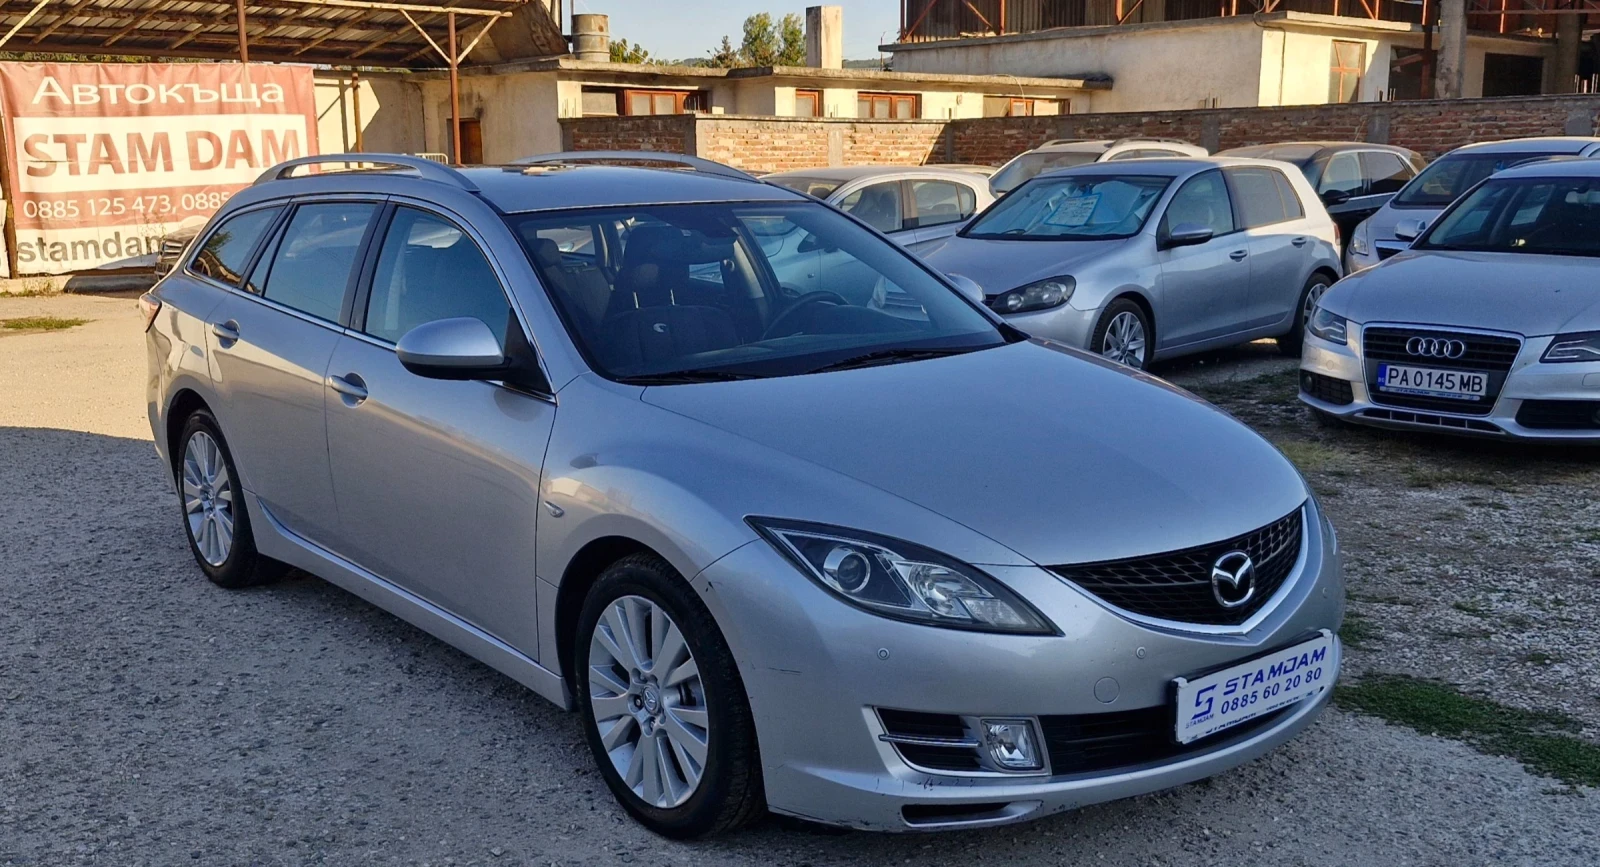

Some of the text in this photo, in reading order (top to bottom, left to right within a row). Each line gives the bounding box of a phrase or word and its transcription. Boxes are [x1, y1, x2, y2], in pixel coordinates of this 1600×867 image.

[32, 76, 284, 107] Автокъща
[23, 129, 300, 177] STAM DAM
[23, 199, 80, 219] 0885
[87, 197, 126, 215] 125
[131, 195, 177, 214] 473,
[1388, 367, 1483, 393] PA 0145 MB
[1223, 646, 1326, 696] STAMDAM
[1221, 690, 1258, 715] 0885
[1263, 682, 1280, 700] 60
[1284, 674, 1301, 692] 20
[1305, 667, 1322, 684] 80
